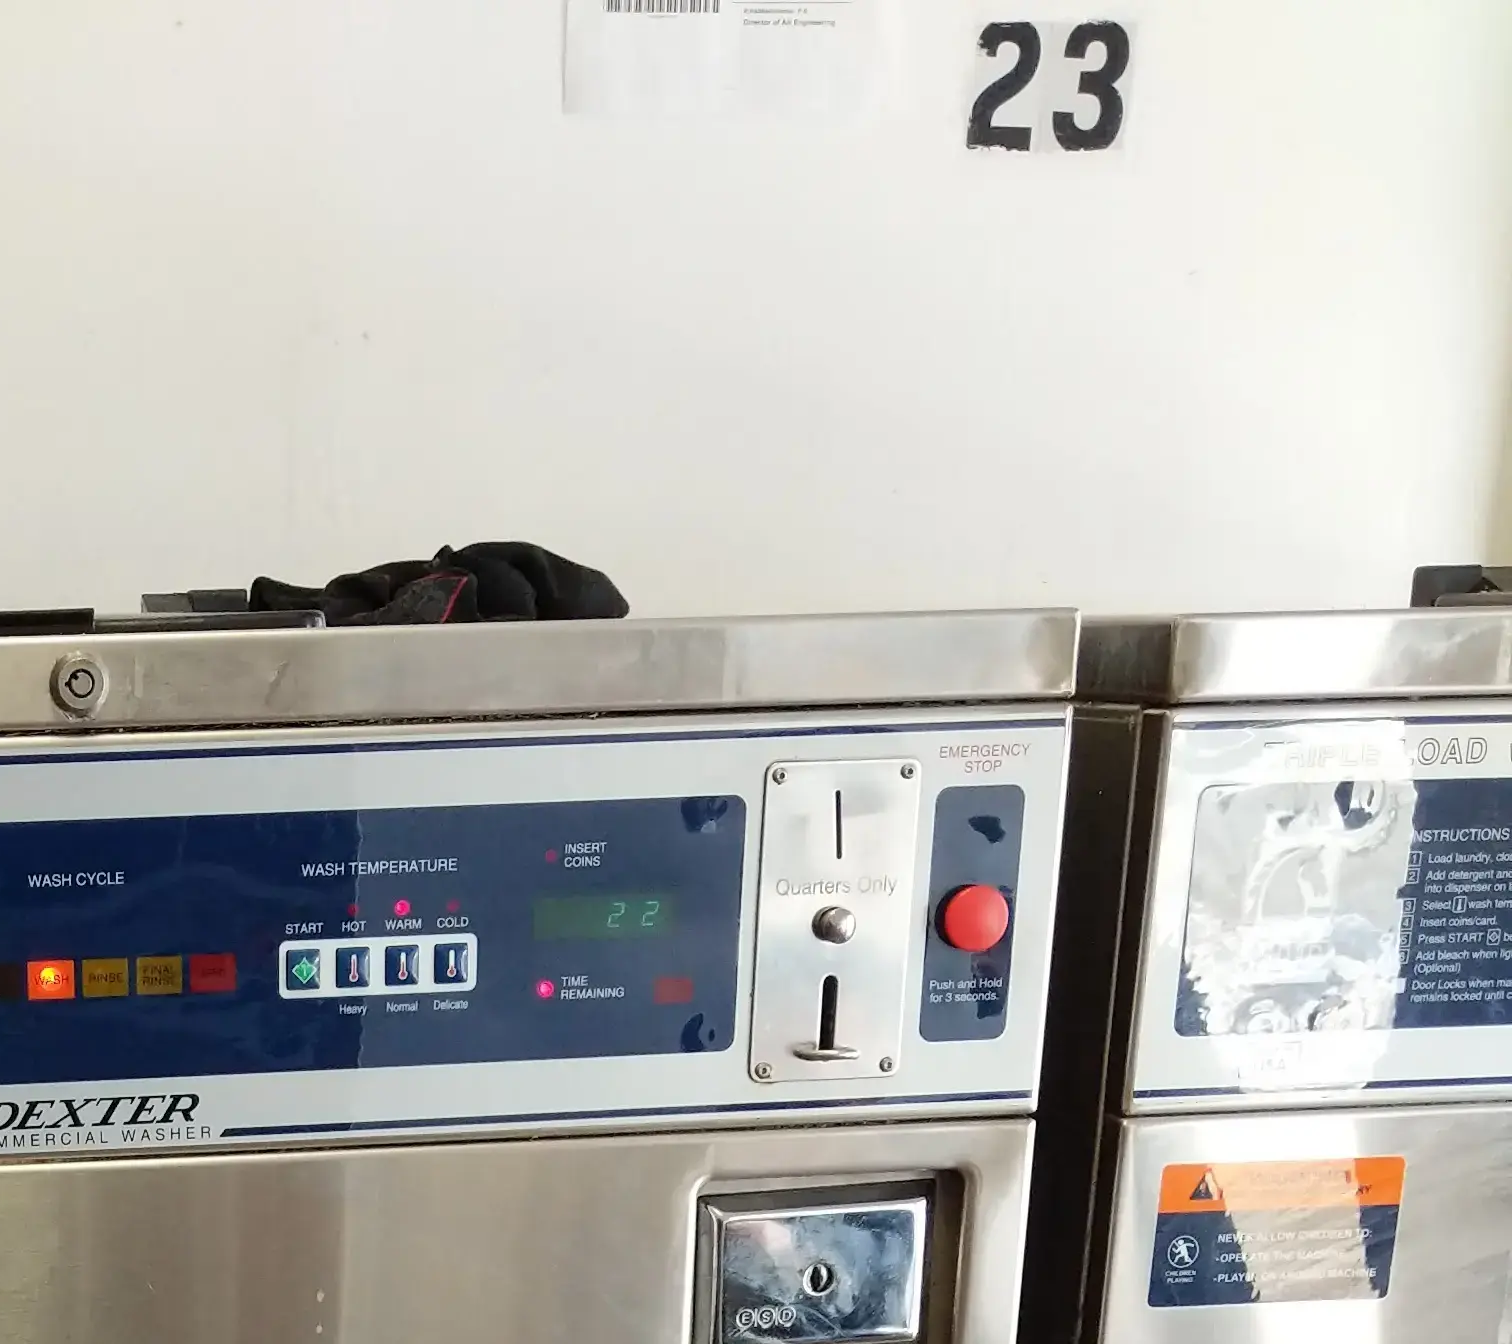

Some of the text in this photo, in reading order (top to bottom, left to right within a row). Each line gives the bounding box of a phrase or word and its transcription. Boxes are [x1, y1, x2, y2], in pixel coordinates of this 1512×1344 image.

[966, 19, 1130, 151] 23
[939, 744, 1032, 759] EMERGENCY
[1407, 738, 1488, 765] OAD
[964, 760, 1002, 773] STOP
[565, 842, 607, 854] INSERT
[302, 858, 458, 877] WASH TEMPERATURE
[564, 856, 600, 868] COINS
[28, 871, 124, 889] WASH CYCLE
[777, 876, 897, 897] Quarters Only
[286, 923, 323, 934] START
[342, 921, 366, 932] HOT
[385, 918, 422, 930] WARM
[437, 917, 469, 928] COLD
[561, 976, 588, 986] TIME
[930, 977, 1003, 990] Push and Hold
[561, 987, 625, 1000] REMAINING
[930, 990, 998, 1002] for 3 seconds.
[340, 1004, 367, 1016] Heavy
[387, 1002, 418, 1012] Normal
[434, 1000, 468, 1010] Delicate
[122, 1126, 212, 1143] WASHER
